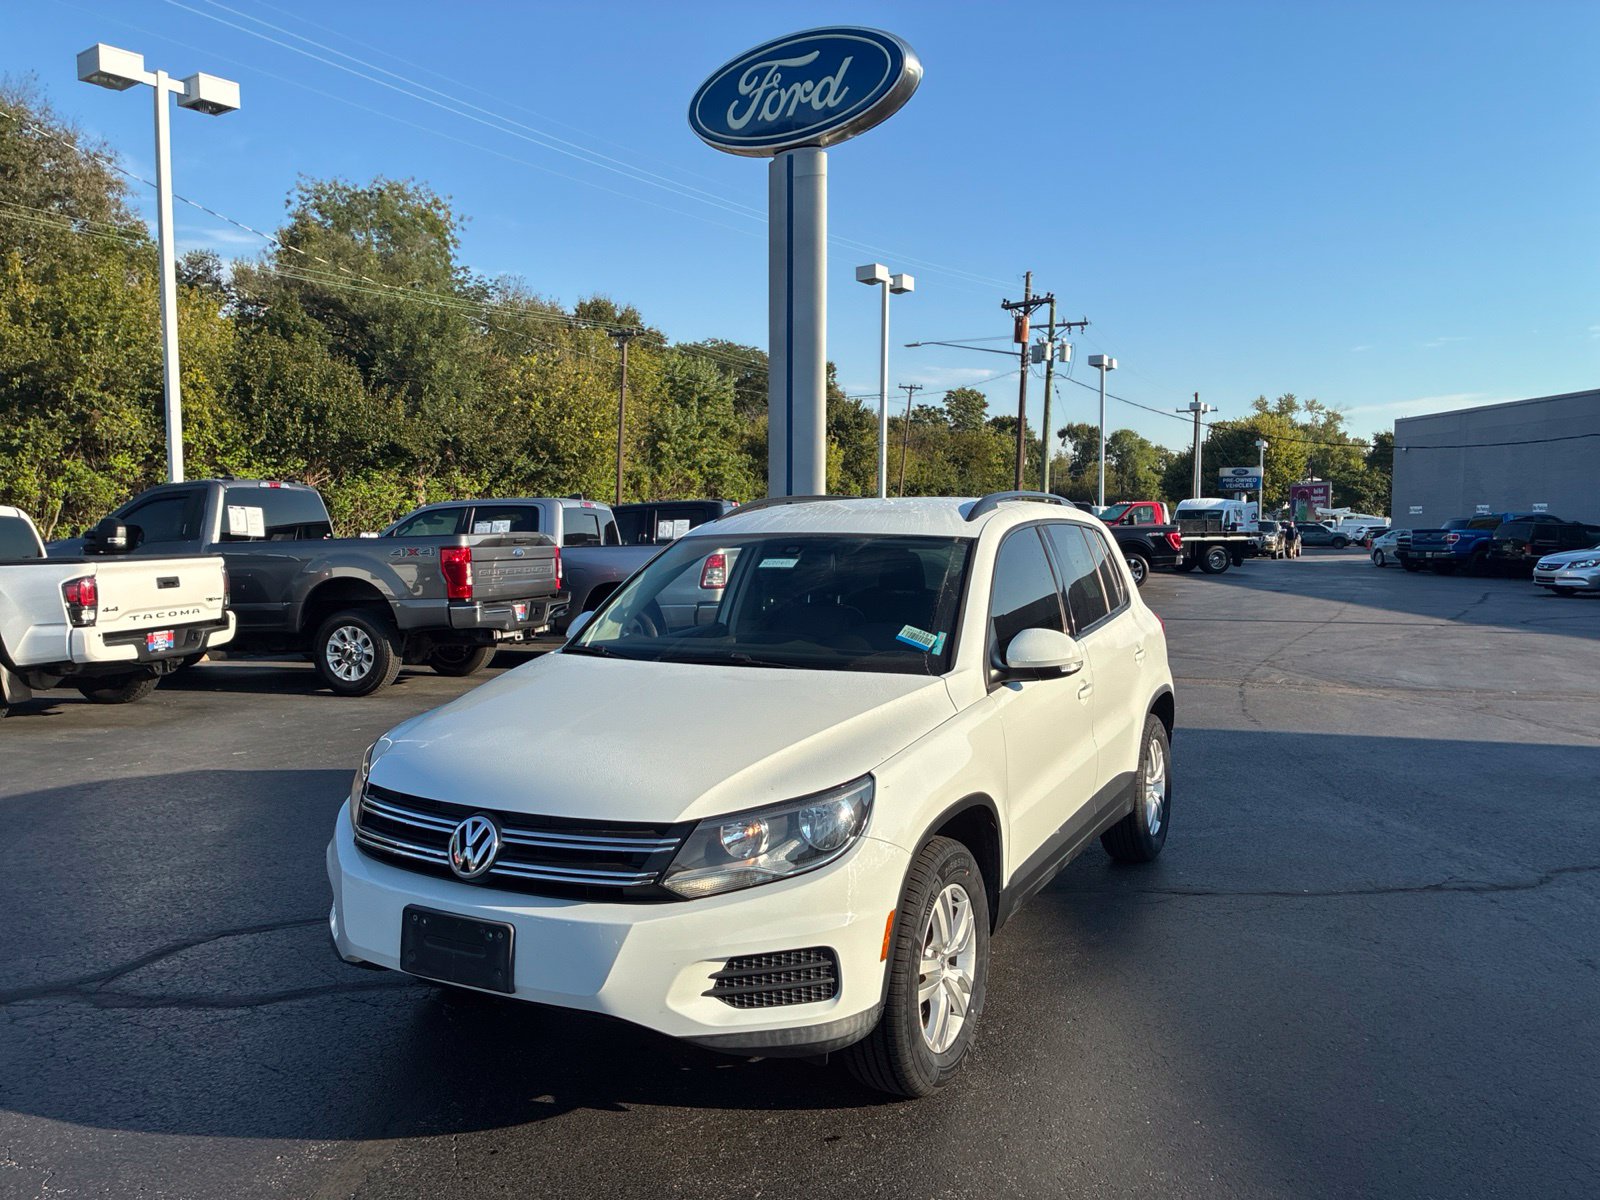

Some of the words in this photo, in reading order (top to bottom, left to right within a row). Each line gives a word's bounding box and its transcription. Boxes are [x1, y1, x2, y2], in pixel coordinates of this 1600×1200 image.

[726, 50, 854, 130] Ford
[479, 567, 522, 577] SUPER
[129, 608, 201, 621] TACOMA
